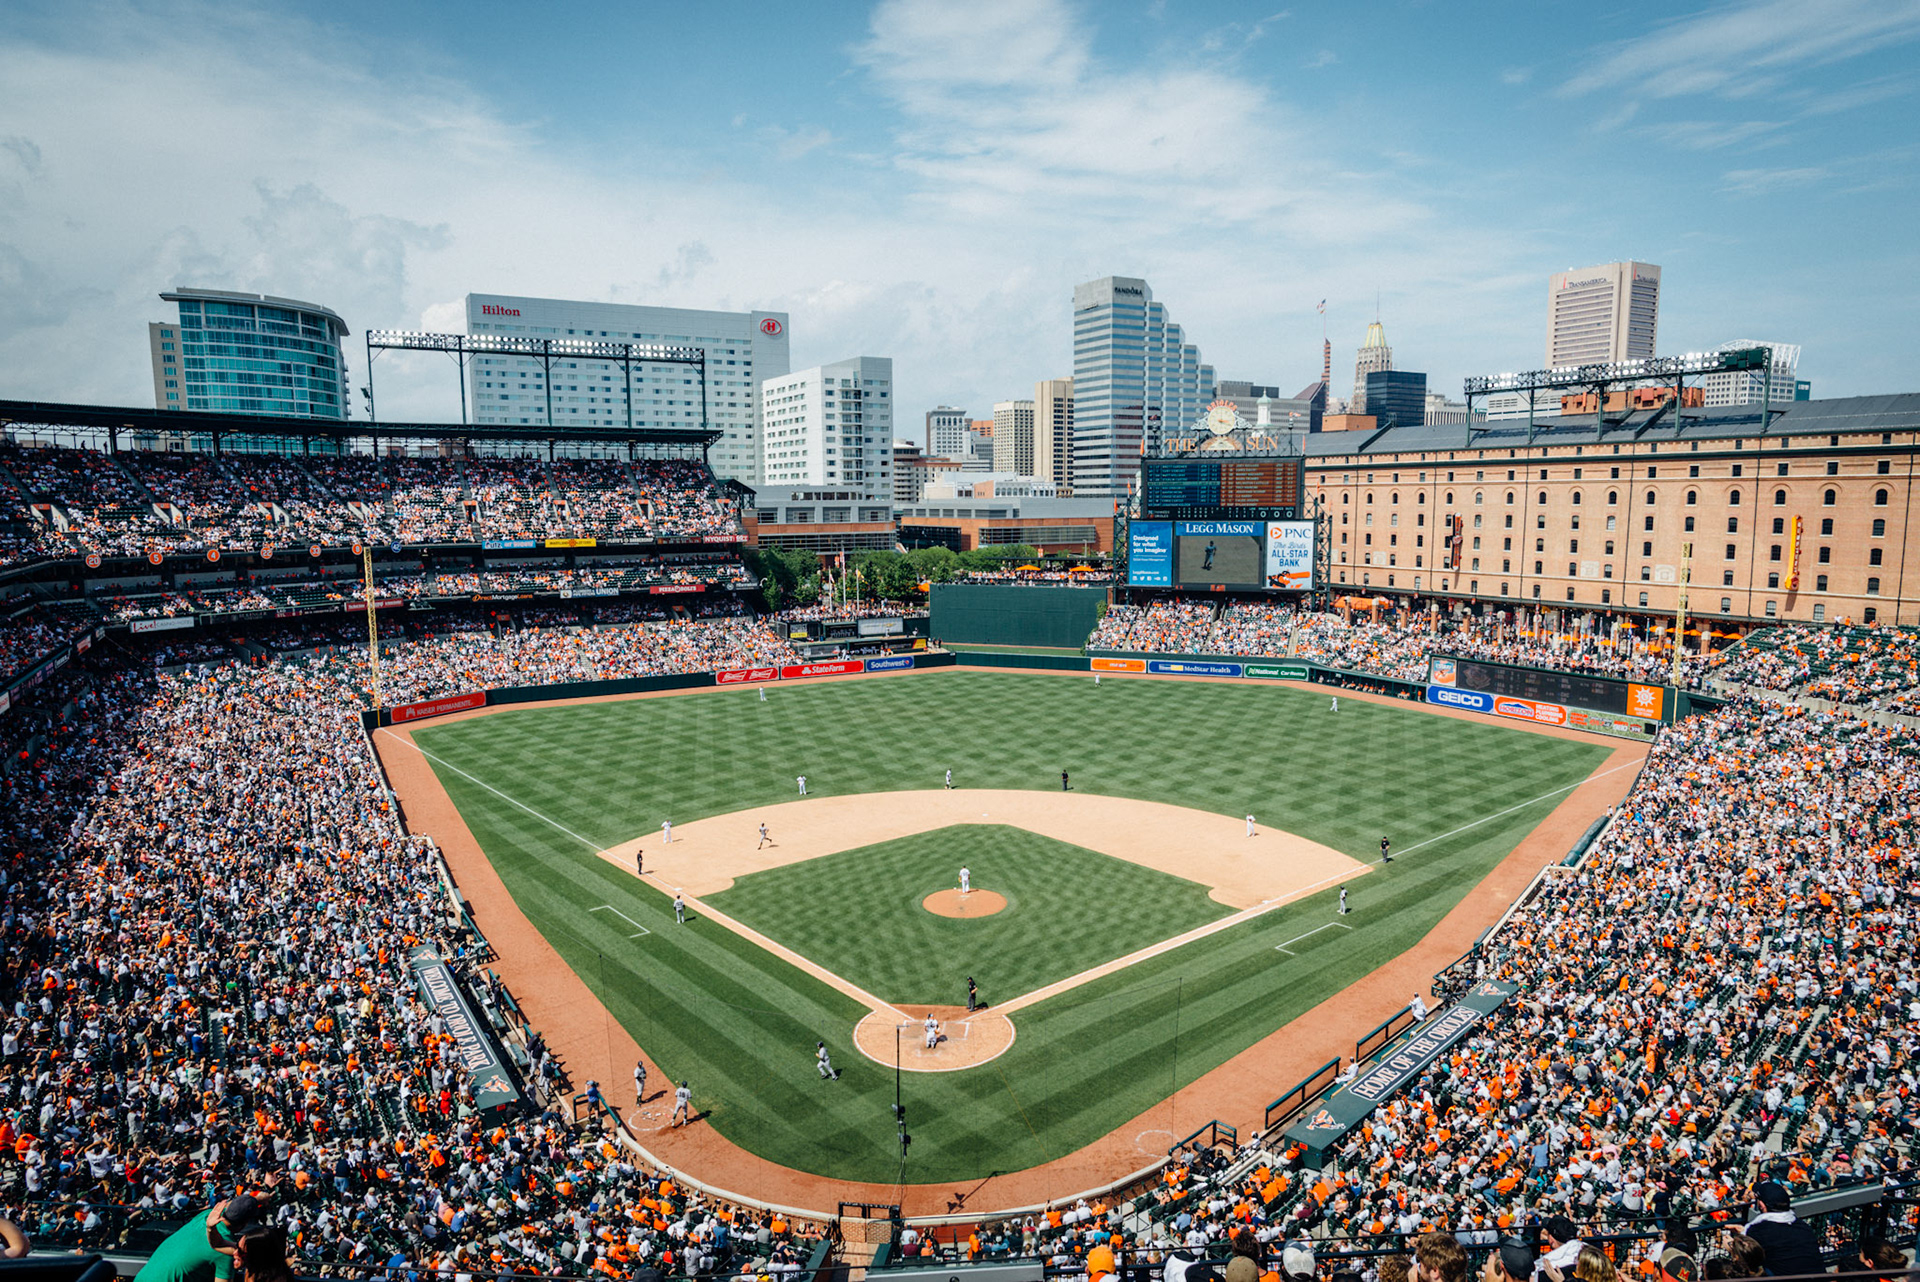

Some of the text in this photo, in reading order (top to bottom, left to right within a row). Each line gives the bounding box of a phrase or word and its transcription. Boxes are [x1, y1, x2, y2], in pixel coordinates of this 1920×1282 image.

[482, 305, 521, 317] Hilton
[1206, 399, 1238, 411] ORIOLES
[1165, 436, 1278, 452] THE SUN
[1260, 510, 1267, 518] 0
[1274, 510, 1280, 518] 0
[1286, 510, 1293, 518] 0
[1186, 523, 1254, 534] LEGG MASON
[1285, 528, 1311, 539] PNC
[1273, 541, 1307, 549] The Birds
[1271, 549, 1309, 558] ALL-STAR
[88, 557, 98, 565] 20
[1279, 558, 1300, 567] BANK
[595, 587, 619, 595] UNION
[133, 620, 157, 633] Live!
[871, 659, 905, 669] Southwest
[1210, 666, 1231, 674] Health
[1437, 690, 1483, 708] GEICO
[417, 699, 472, 716] KAISER PERMANENTE
[1499, 705, 1533, 716] HORIZON
[421, 966, 491, 1070] WELCOME TO ORIOLE PARK
[1353, 1007, 1477, 1099] HOME OF THE ORIOLES
[1631, 1189, 1642, 1198] 28
[1195, 1236, 1201, 1244] 2
[1677, 1267, 1690, 1282] M
